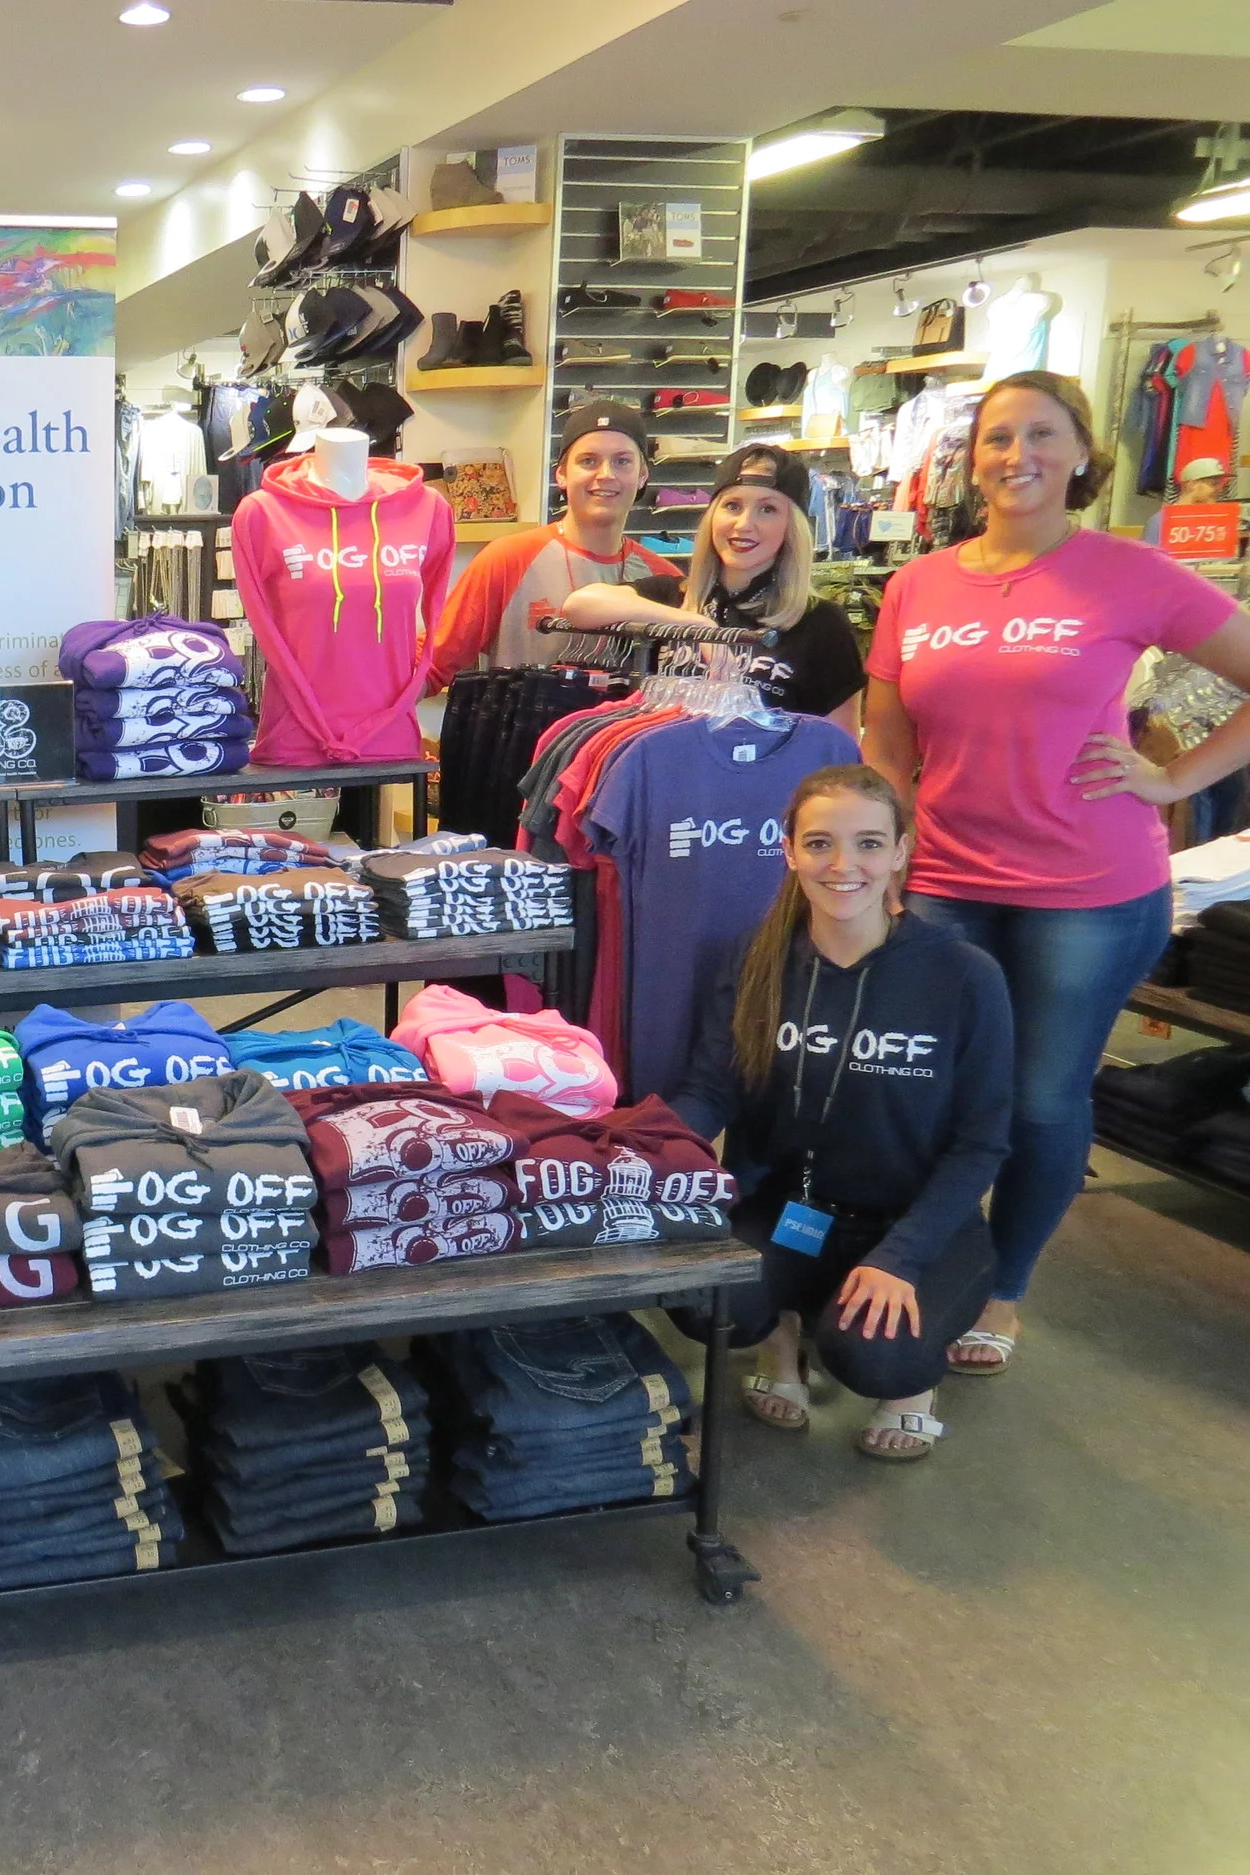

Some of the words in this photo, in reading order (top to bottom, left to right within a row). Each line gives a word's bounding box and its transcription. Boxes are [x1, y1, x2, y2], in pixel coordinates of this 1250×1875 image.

[502, 154, 531, 167] TOMS
[1002, 617, 1085, 642] OFF
[998, 645, 1059, 654] CLOTHING
[28, 659, 49, 678] of
[852, 1028, 938, 1063] OFF
[849, 1062, 911, 1076] CLOTHING
[456, 1142, 488, 1162] OFF
[226, 1171, 314, 1207] OFF
[514, 1158, 595, 1203] FOG
[660, 1170, 735, 1204] OFF
[452, 1199, 485, 1214] OFF
[220, 1211, 305, 1241] OFF
[221, 1242, 288, 1253] CLOTHING
[461, 1233, 492, 1252] OFF
[223, 1270, 287, 1286] CLOTHING
